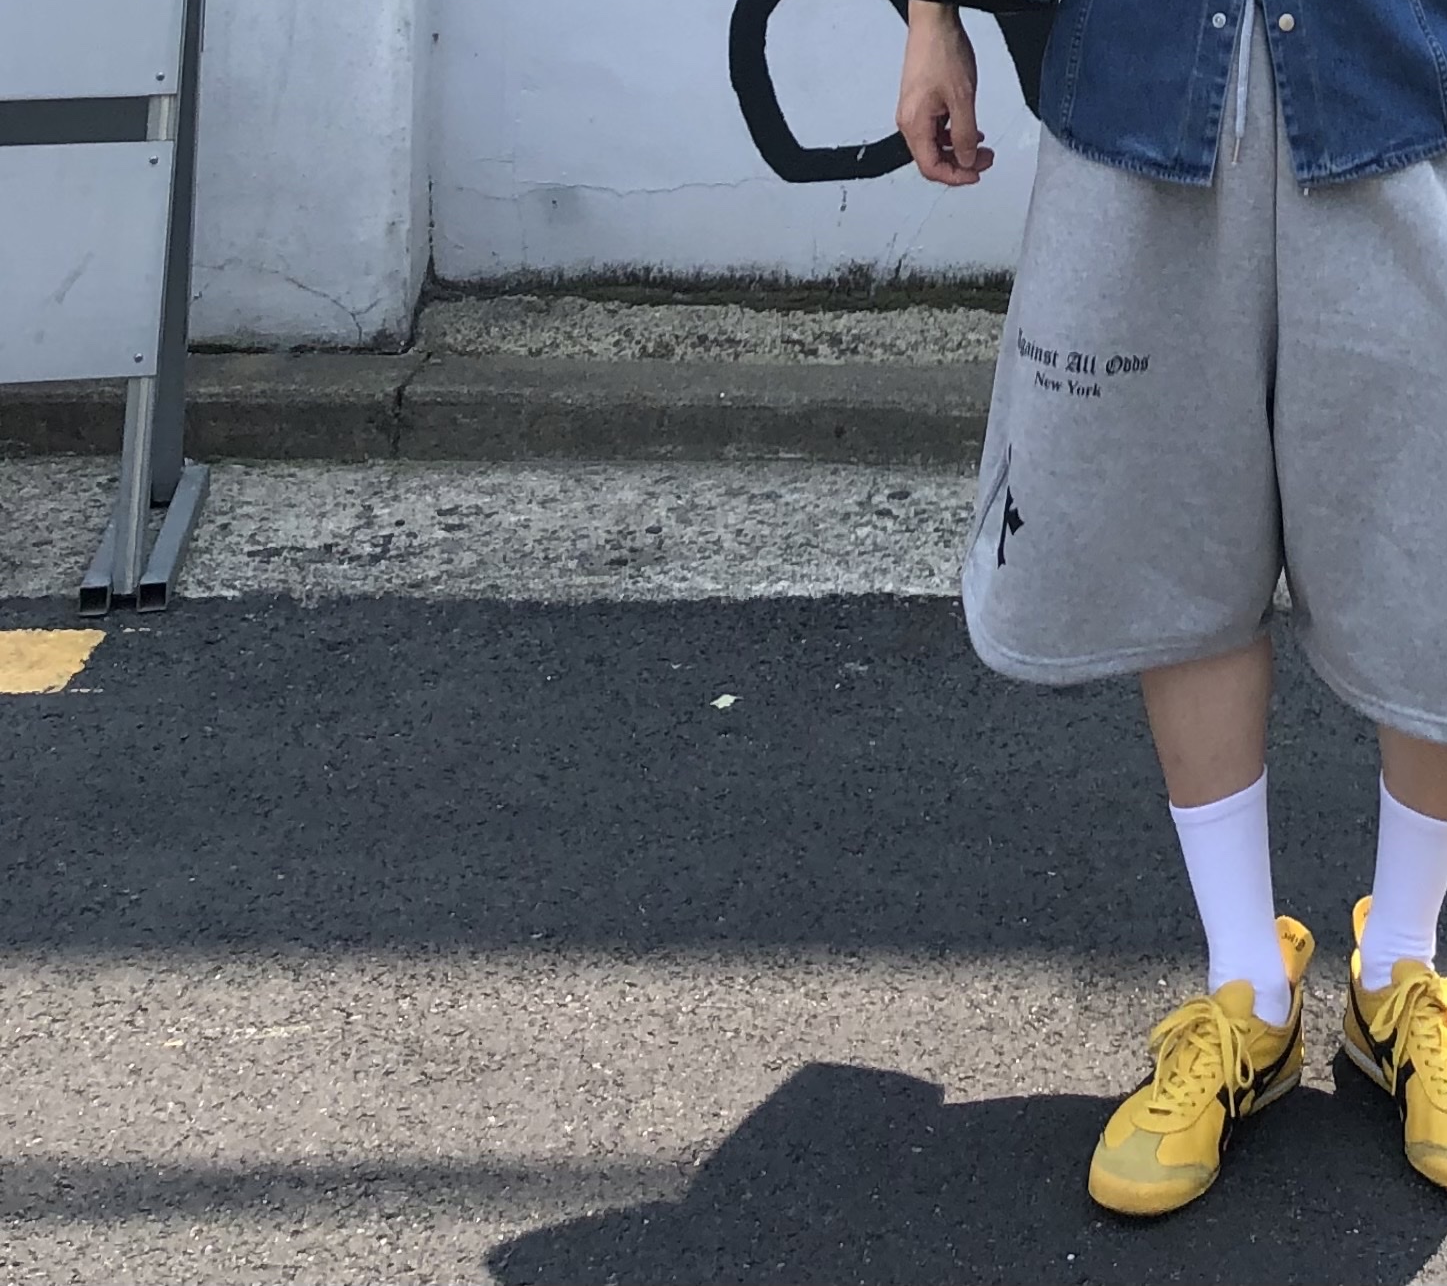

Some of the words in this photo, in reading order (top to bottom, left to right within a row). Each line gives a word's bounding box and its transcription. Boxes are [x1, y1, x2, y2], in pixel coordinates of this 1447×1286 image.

[1065, 351, 1096, 375] All
[1034, 370, 1061, 392] New
[1067, 379, 1101, 399] York
